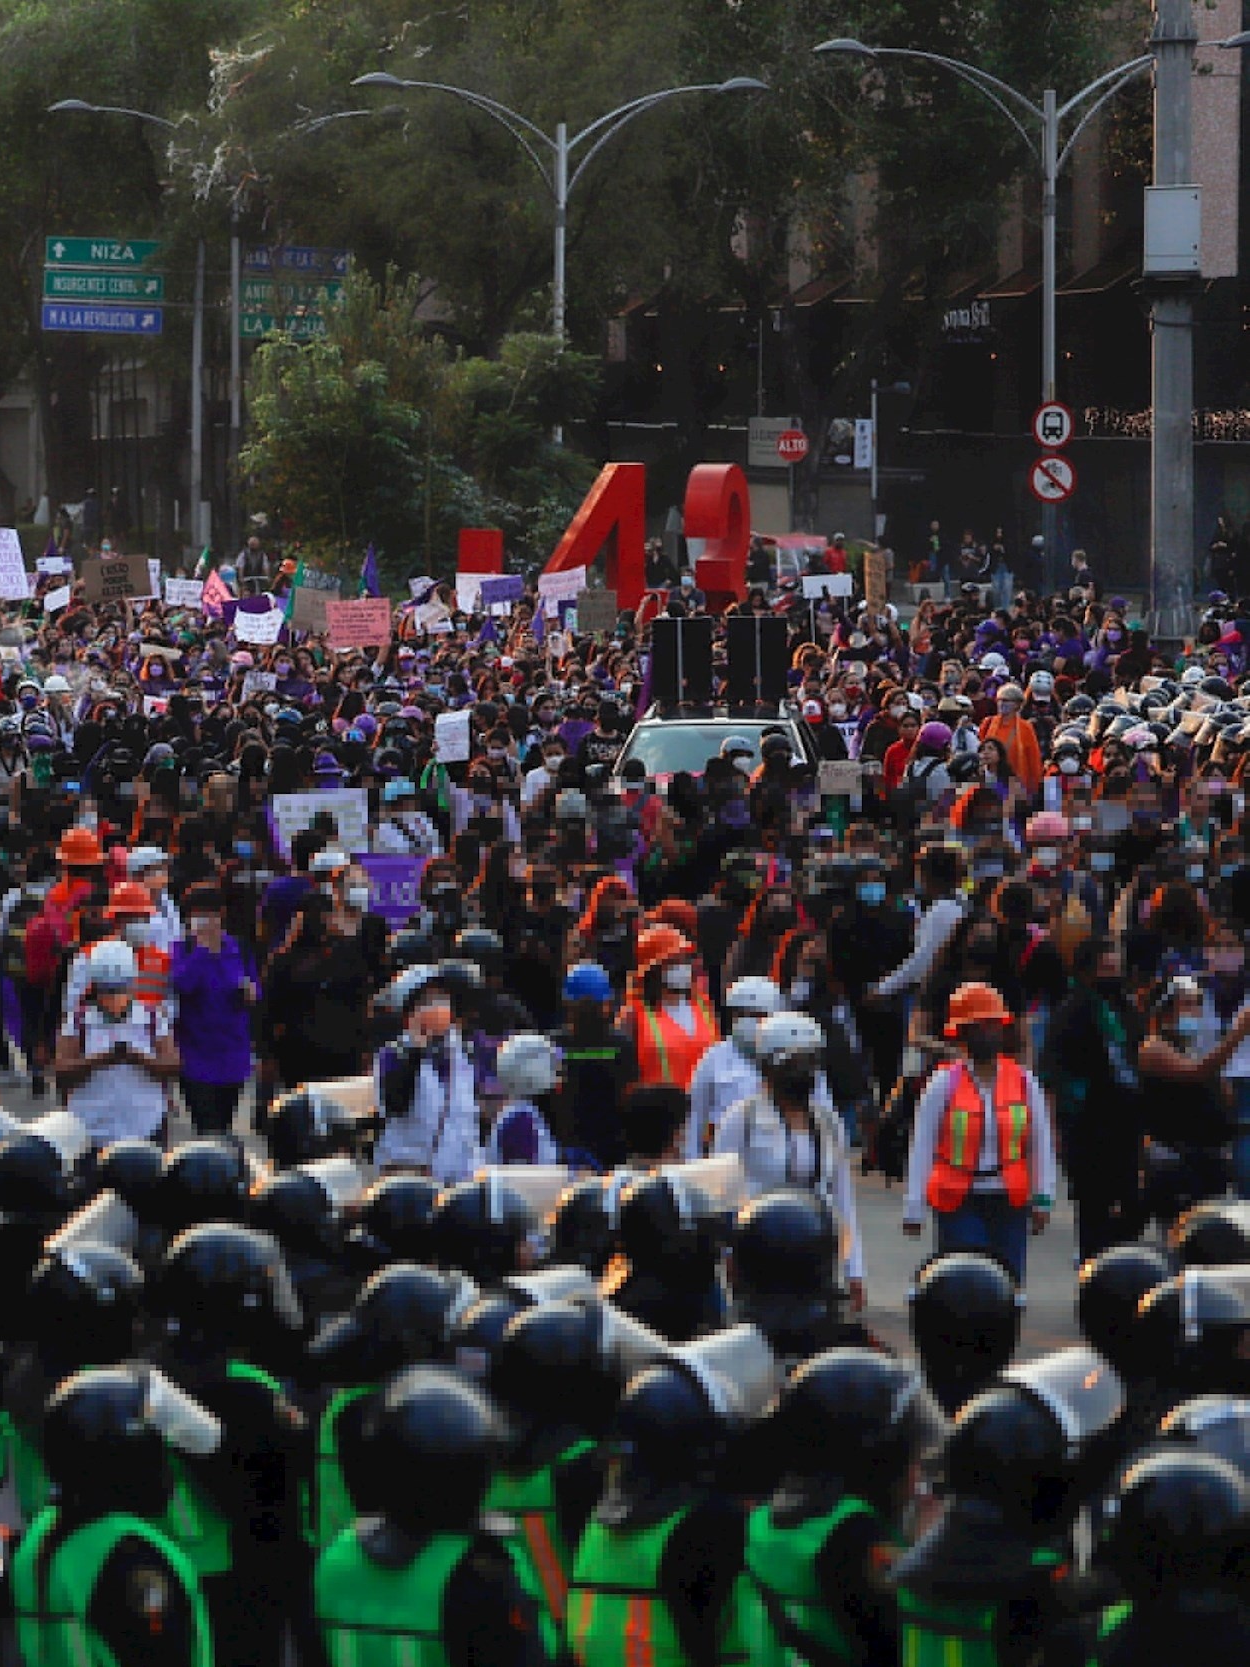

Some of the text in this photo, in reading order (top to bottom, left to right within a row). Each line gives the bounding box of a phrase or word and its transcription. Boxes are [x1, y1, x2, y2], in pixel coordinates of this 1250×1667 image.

[90, 244, 135, 260] NIZA
[53, 277, 106, 292] INSURGENTES
[59, 311, 67, 324] A
[69, 312, 82, 325] LA
[778, 440, 807, 452] ALTO
